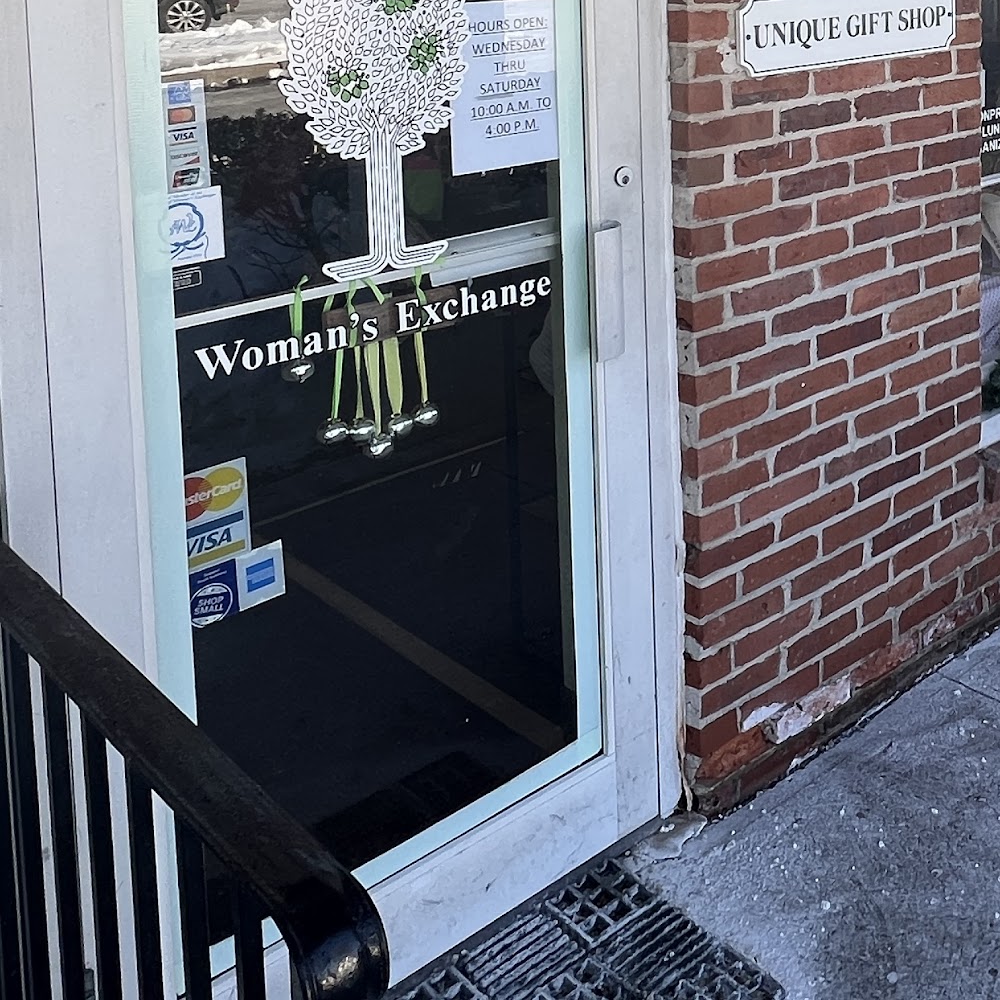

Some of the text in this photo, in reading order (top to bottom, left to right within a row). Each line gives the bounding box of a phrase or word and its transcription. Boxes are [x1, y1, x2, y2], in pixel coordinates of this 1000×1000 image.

[468, 16, 548, 33] HOURS OPEN:
[753, 3, 946, 51] UNIQUE GIFT SHOP
[472, 37, 546, 55] WEDNESDAY
[494, 59, 526, 73] THRU
[480, 77, 541, 95] SATURDAY
[471, 96, 552, 119] 10:00 A.M. TO
[173, 131, 195, 141] VISA
[485, 118, 540, 136] 4:00 P.M.
[194, 275, 552, 380] Woman's Exchange
[185, 478, 242, 506] sterCard
[187, 527, 232, 557] VISA
[193, 603, 224, 615] SMALL
[198, 595, 224, 607] SHOP
